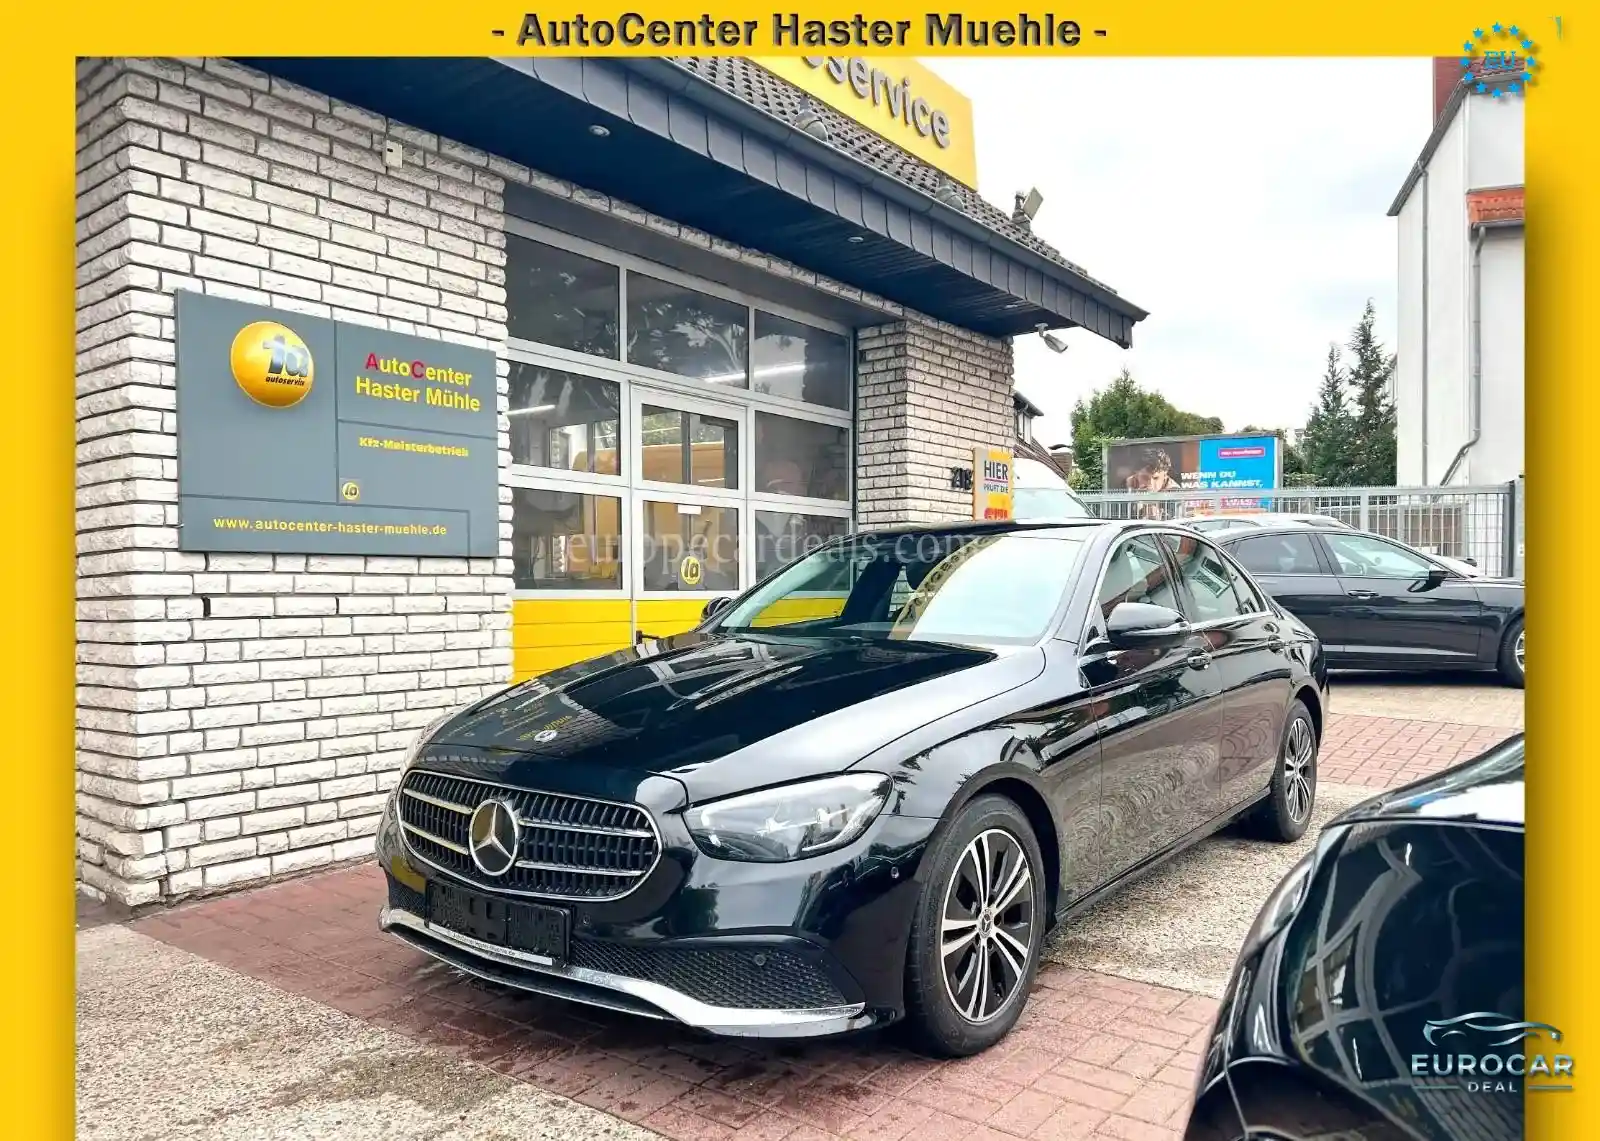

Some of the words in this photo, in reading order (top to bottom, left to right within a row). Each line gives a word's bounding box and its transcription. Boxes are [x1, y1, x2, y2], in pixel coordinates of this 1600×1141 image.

[365, 352, 473, 387] AutoCenter
[356, 376, 421, 403] Haster
[426, 387, 481, 412] Mühle
[359, 437, 469, 457] Kfz-Meisterbetrieb
[984, 460, 1008, 480] HIER
[1181, 471, 1216, 480] WENN
[1219, 470, 1236, 479] DU
[213, 517, 447, 536] www.autocenter-haster-muehle.de
